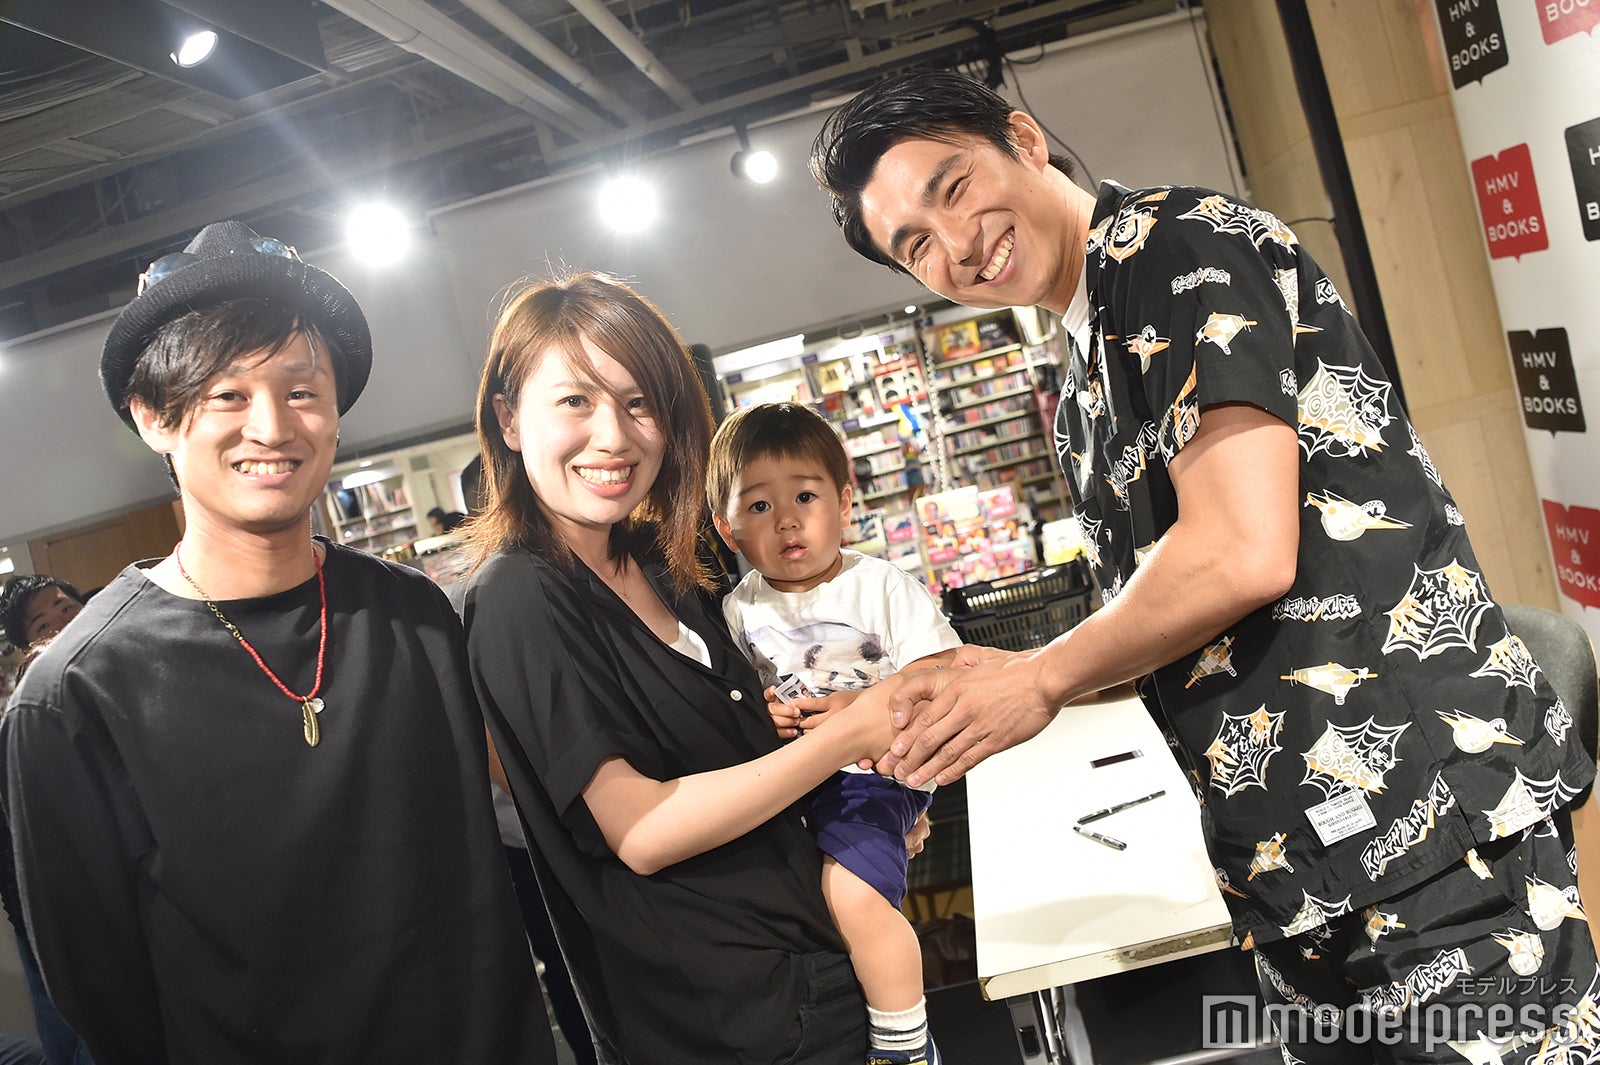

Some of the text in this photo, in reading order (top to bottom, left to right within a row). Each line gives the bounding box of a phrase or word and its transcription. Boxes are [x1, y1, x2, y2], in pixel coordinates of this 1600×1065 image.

[1465, 21, 1476, 38] &
[1451, 32, 1501, 71] BOOKS
[1485, 171, 1519, 195] HMV
[1502, 198, 1514, 215] &
[1487, 215, 1541, 242] BOOKS
[1521, 351, 1557, 368] HMV
[1539, 374, 1550, 391] &
[1523, 396, 1578, 415] BOOKS
[1555, 523, 1590, 545] HMV
[1570, 549, 1582, 565] &
[1558, 564, 1600, 592] BOOK
[1361, 822, 1405, 876] ROUGH
[1404, 802, 1432, 843] AND
[1406, 950, 1465, 1000] RUGGED
